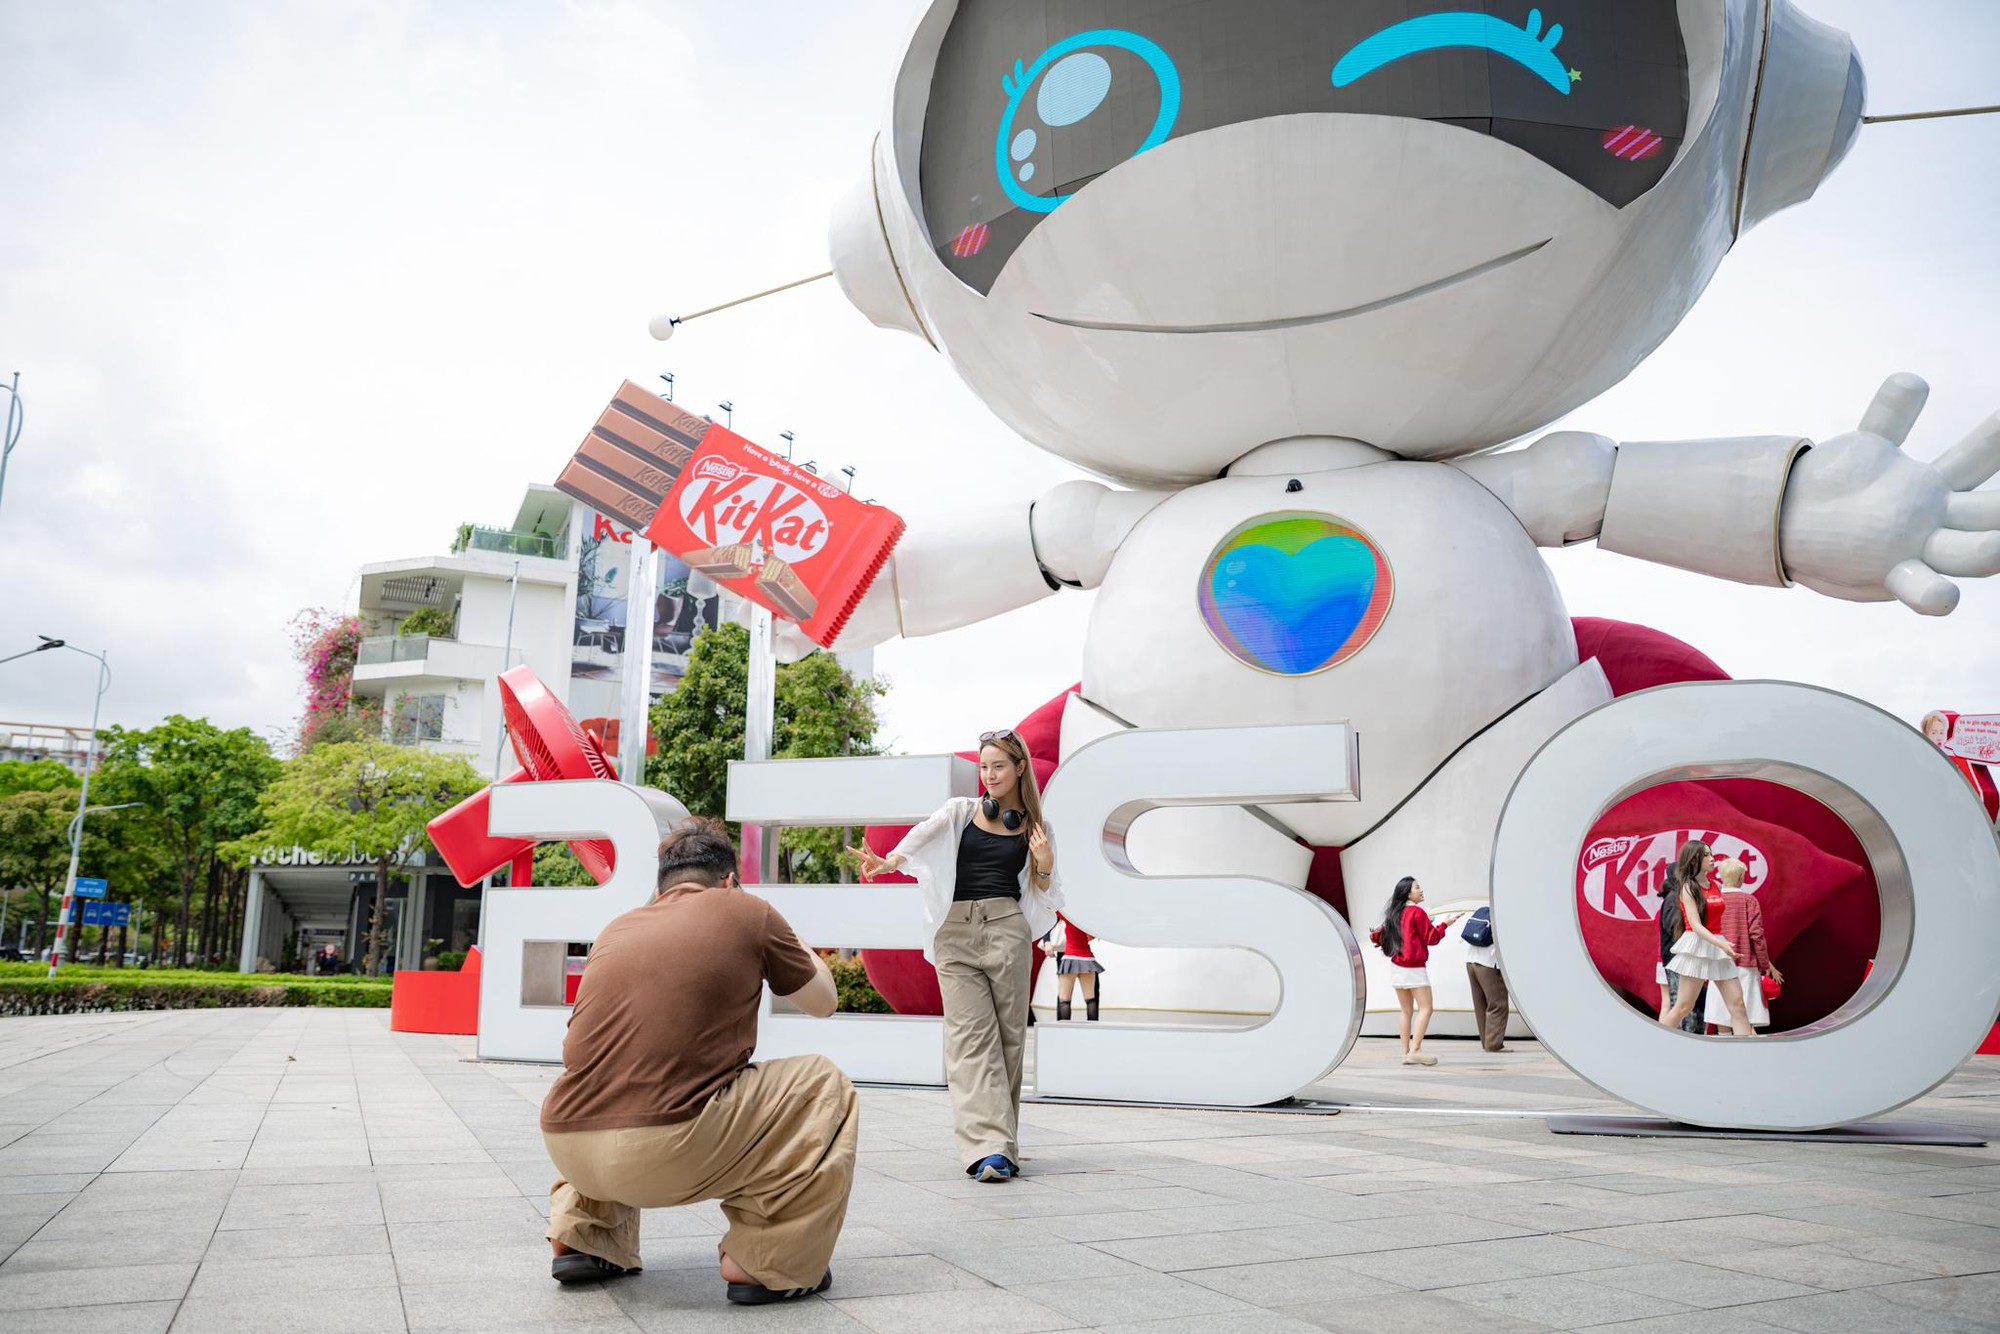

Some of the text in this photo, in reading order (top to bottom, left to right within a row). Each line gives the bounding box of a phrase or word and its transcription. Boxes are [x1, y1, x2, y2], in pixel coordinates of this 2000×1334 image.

[700, 460, 737, 479] Nestlé
[743, 443, 763, 459] Have
[793, 470, 811, 485] have
[686, 474, 826, 554] KitKat
[250, 840, 400, 866] rochebobos
[1589, 840, 1628, 860] Nestlé
[350, 873, 377, 882] PAR
